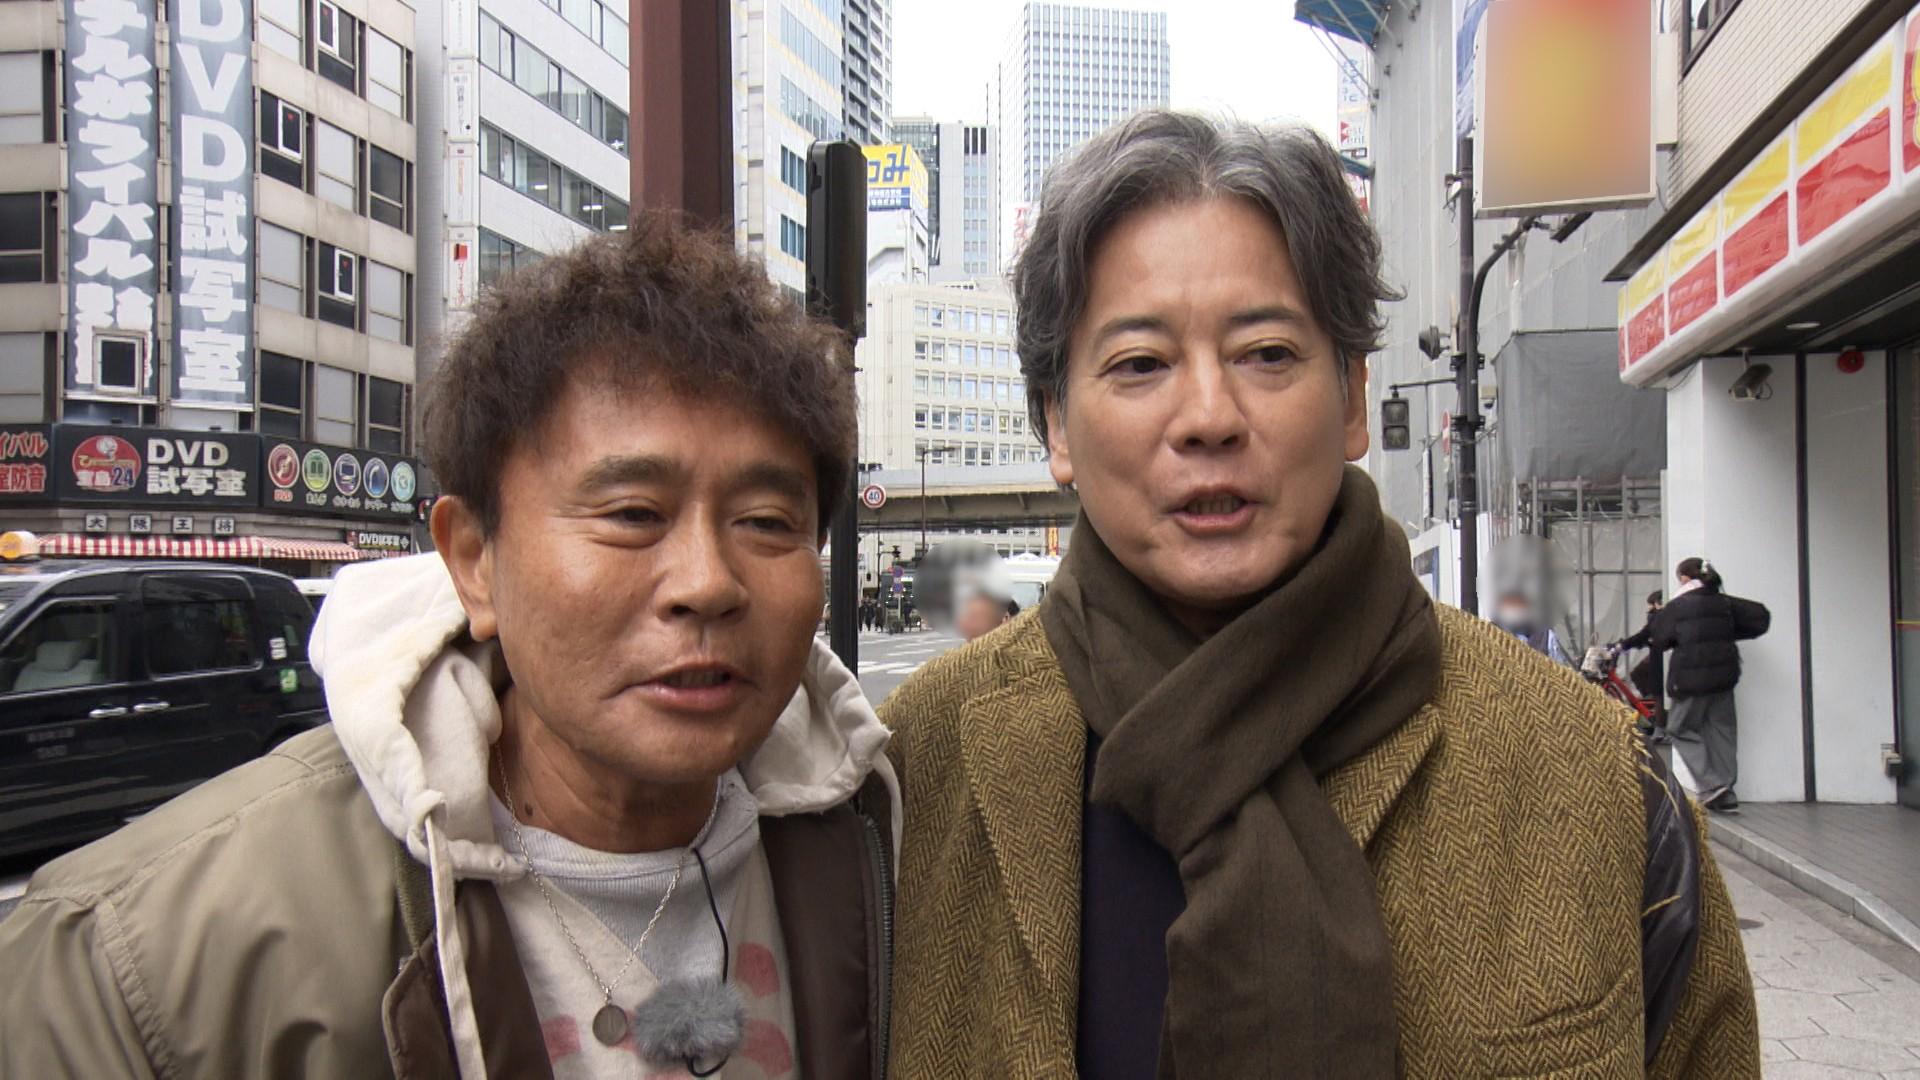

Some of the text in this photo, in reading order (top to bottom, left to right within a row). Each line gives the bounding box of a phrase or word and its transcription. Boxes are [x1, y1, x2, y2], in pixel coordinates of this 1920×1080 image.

[177, 0, 247, 393] DVD試写室
[147, 438, 229, 466] DVD
[146, 465, 247, 496] 試写室
[87, 516, 233, 532] 大阪王将
